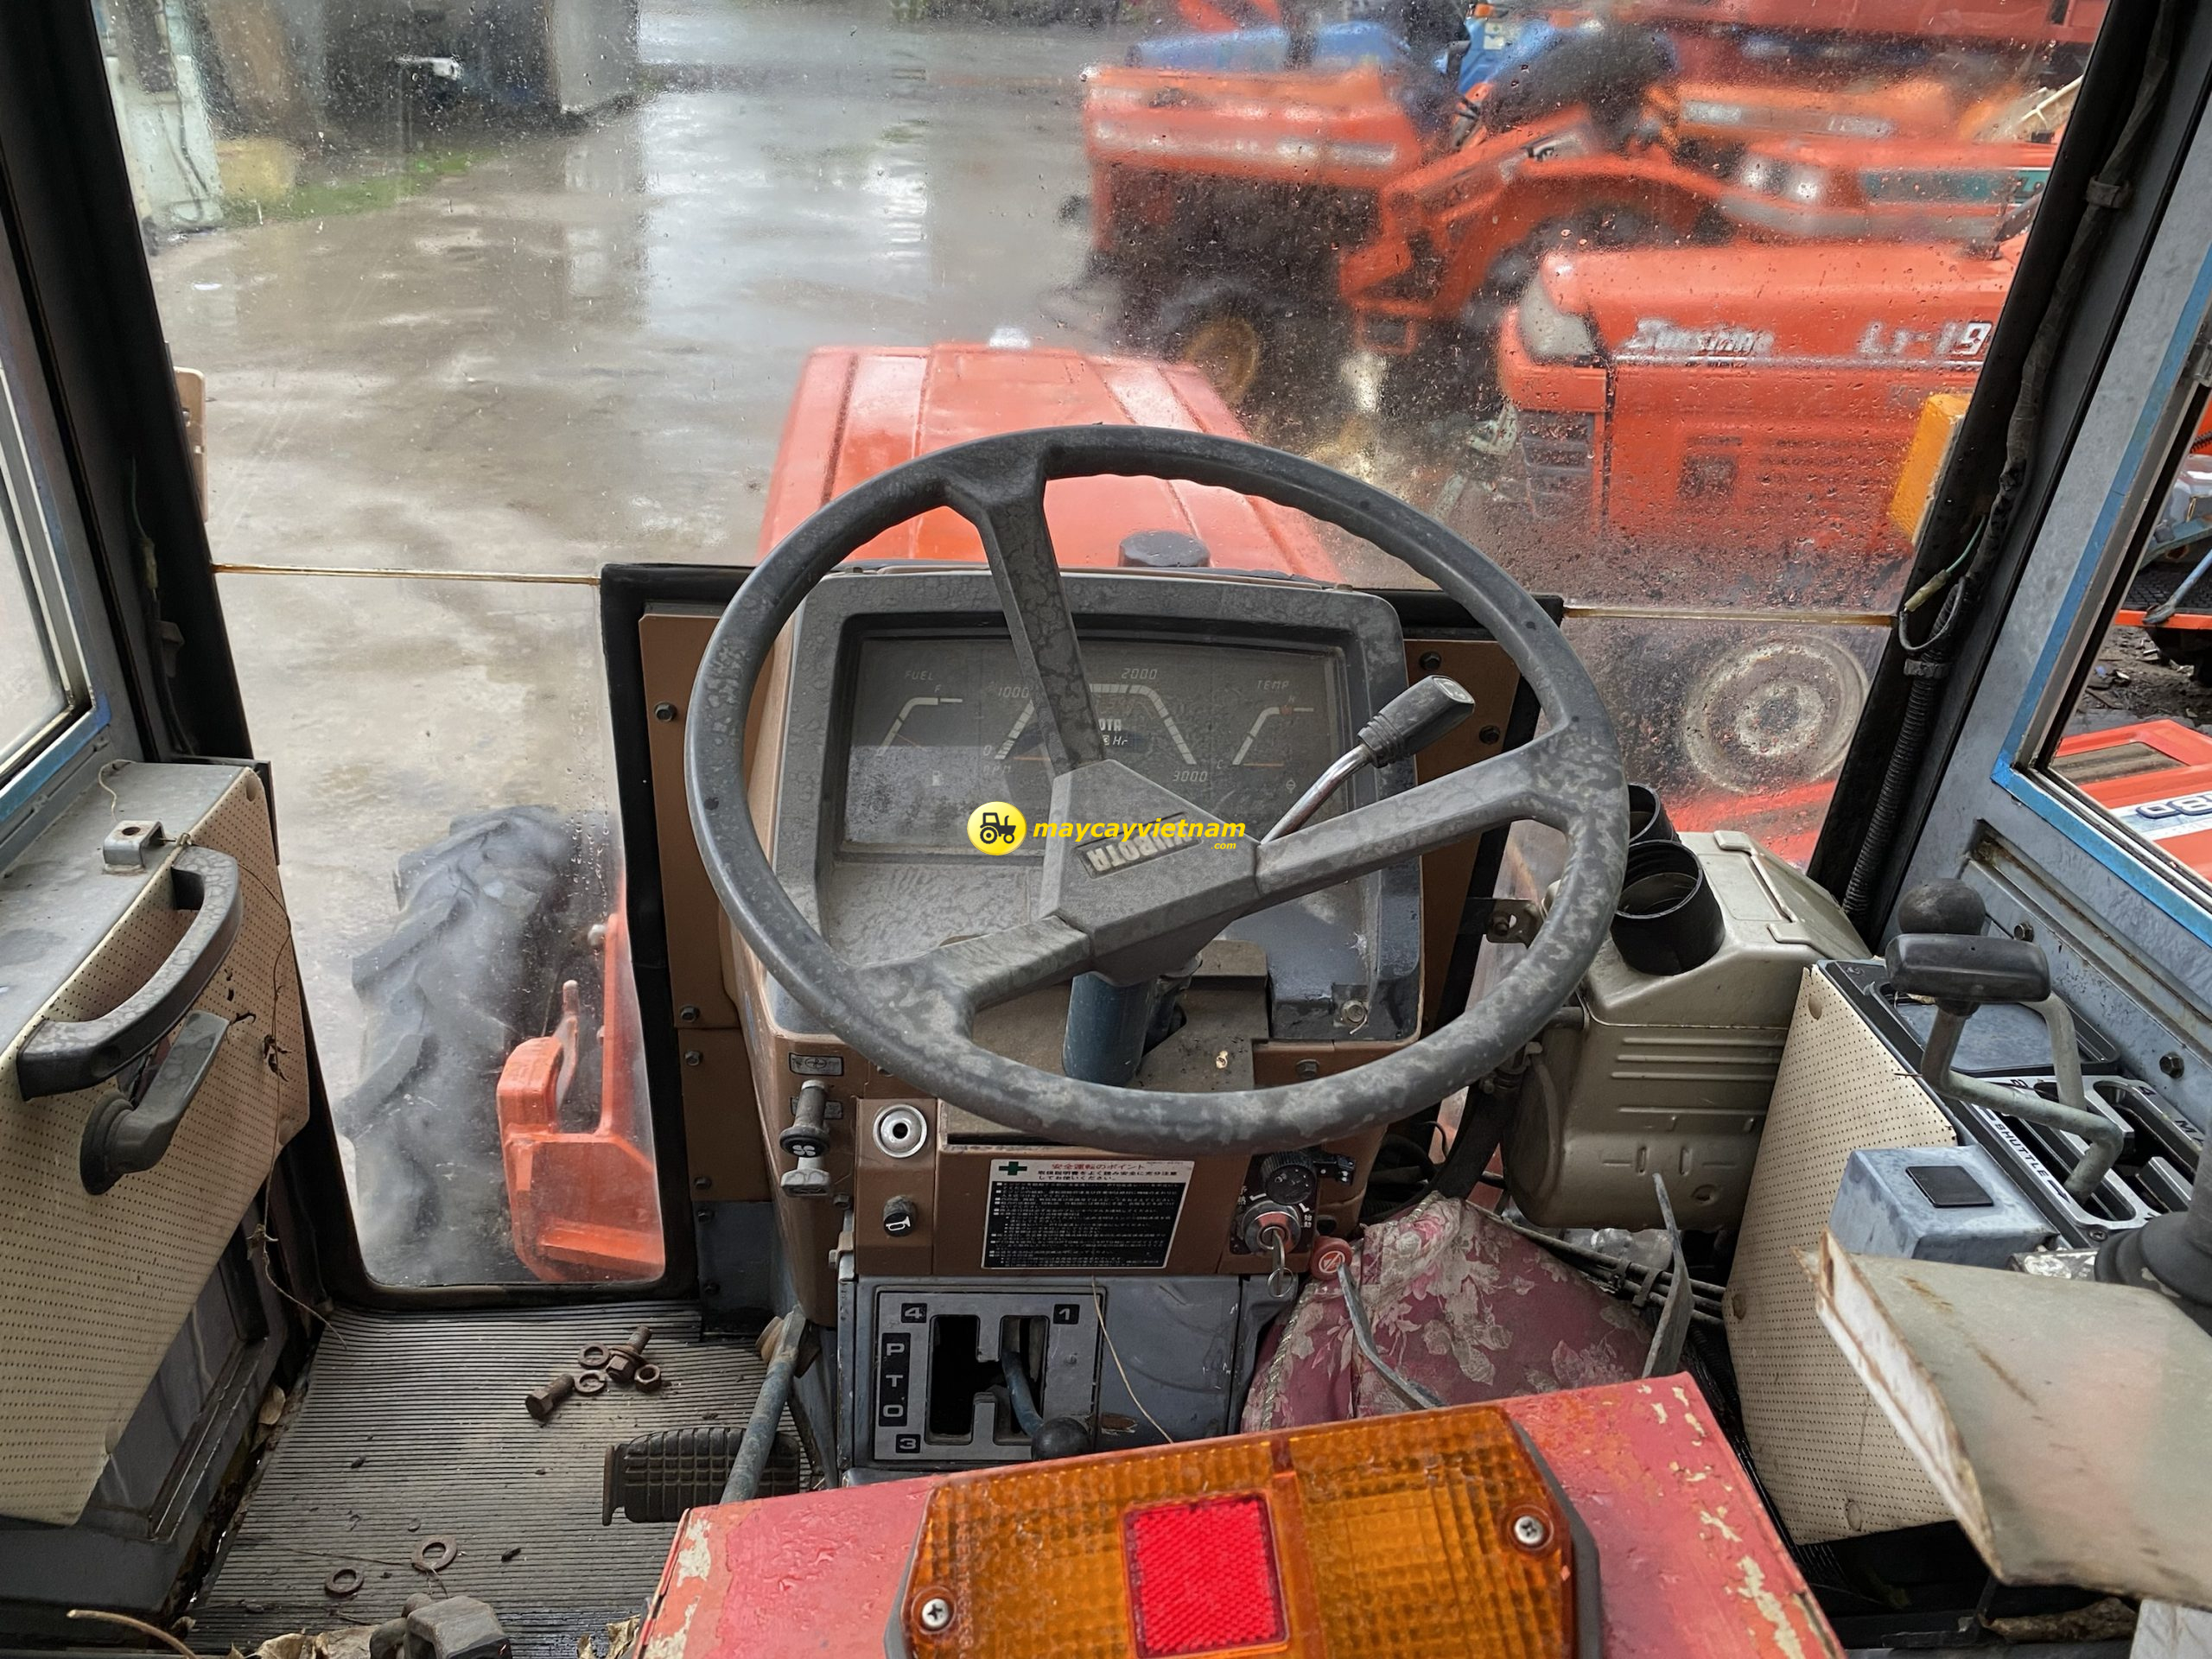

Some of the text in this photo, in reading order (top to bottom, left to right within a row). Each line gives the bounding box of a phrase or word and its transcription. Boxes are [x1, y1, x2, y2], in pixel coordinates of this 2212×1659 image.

[905, 670, 934, 681] FUEL
[1122, 669, 1158, 680] 2000
[1257, 679, 1290, 690] TEMP
[998, 686, 1030, 698] 1000
[1173, 770, 1208, 782] 3000
[1994, 1123, 2050, 1178] SHUTTLE
[904, 1306, 924, 1319] 4
[1058, 1307, 1071, 1320] 1
[882, 1342, 906, 1419] PTO
[899, 1437, 917, 1450] 3
